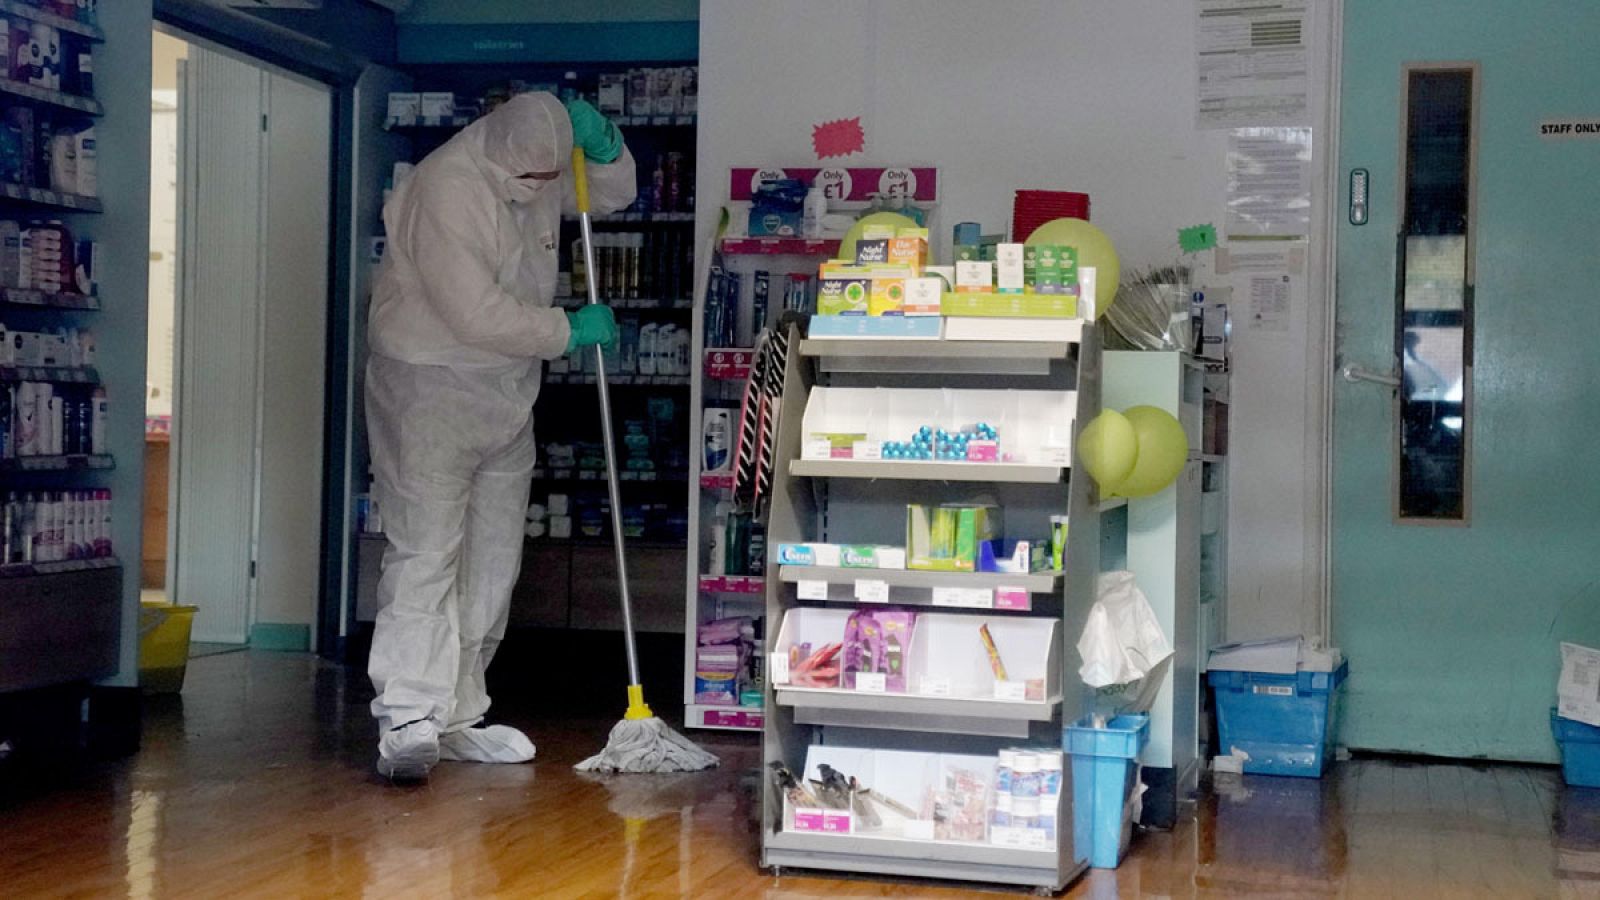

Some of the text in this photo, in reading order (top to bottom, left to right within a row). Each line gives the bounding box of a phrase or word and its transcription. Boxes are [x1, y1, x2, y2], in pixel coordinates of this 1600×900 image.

[1541, 123, 1600, 134] STAFF ONLY
[759, 171, 779, 180] Only
[823, 171, 843, 181] Only
[887, 171, 908, 181] Only
[824, 182, 844, 199] £1
[888, 182, 908, 198] £1
